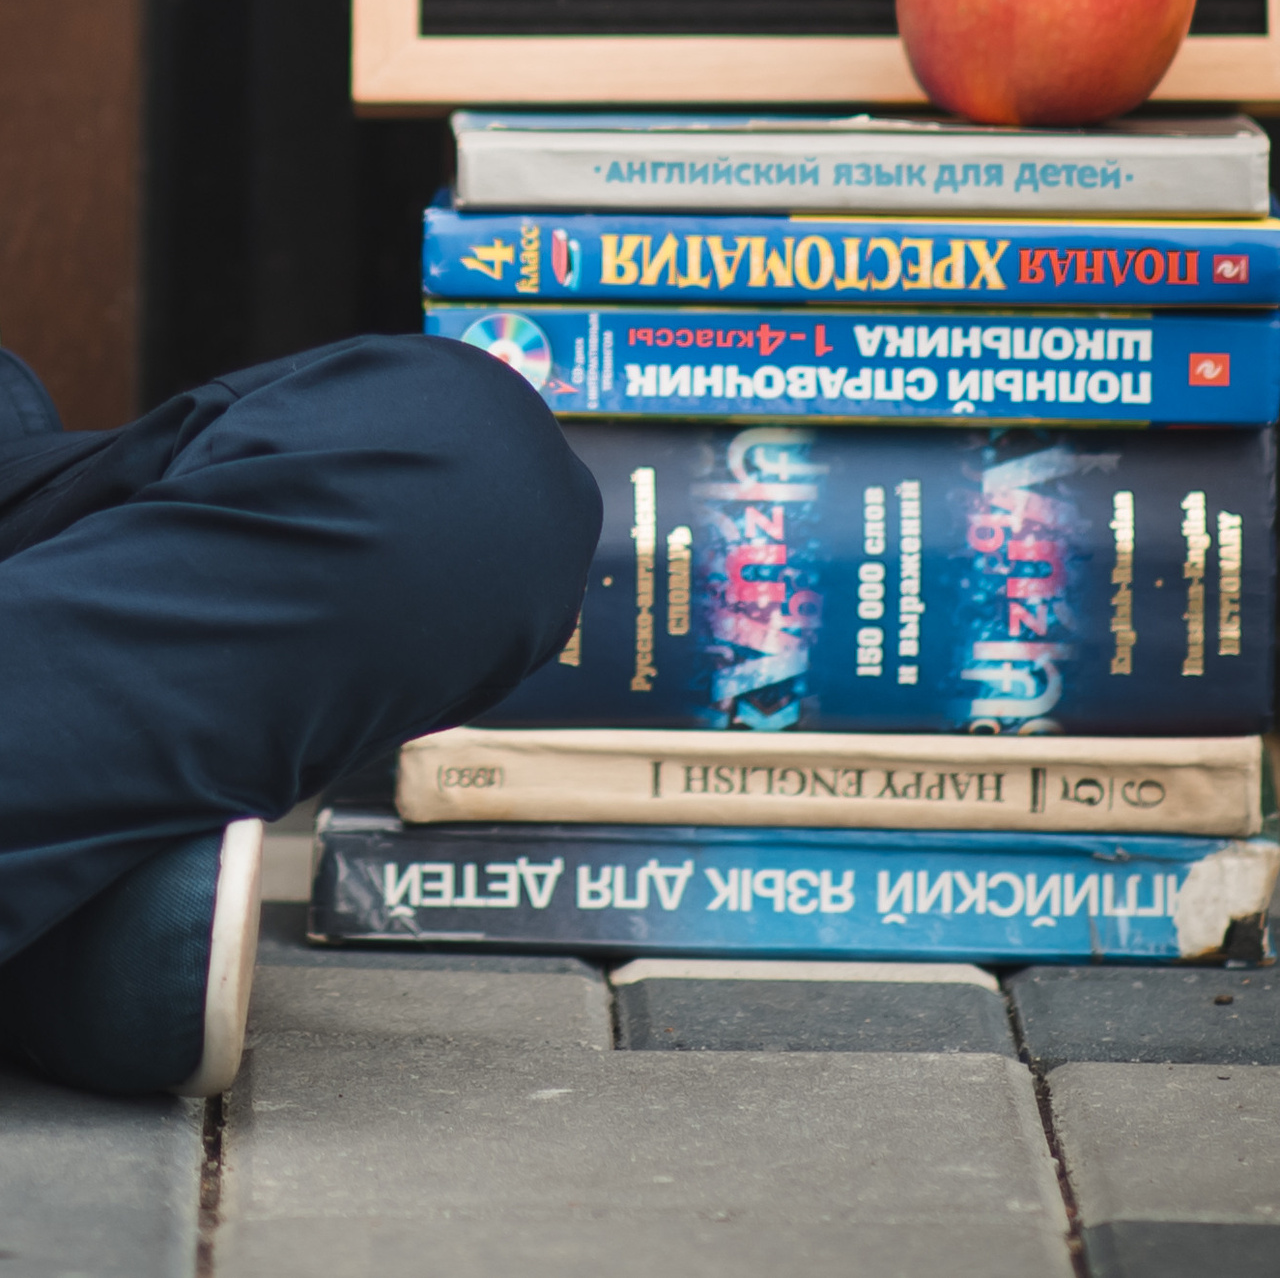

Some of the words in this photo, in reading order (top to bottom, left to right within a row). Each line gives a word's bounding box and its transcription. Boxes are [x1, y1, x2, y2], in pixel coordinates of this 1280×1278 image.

[459, 238, 516, 281] 4
[599, 232, 1011, 291] ХРЕСТОМАТИЯ
[1018, 246, 1201, 288] ПОЛНАЯ
[852, 325, 1154, 362] ШКОЛЬНИКА
[624, 363, 939, 402] СПРАВОЧНИК
[946, 368, 1154, 414] ПОЛНЫЙ
[862, 484, 887, 556] слов
[856, 562, 886, 620] 000
[894, 479, 926, 657] выражений
[1108, 490, 1138, 676] English-Russian
[1180, 490, 1212, 677] Russian-English
[1217, 510, 1243, 657] DICTIONARY
[856, 626, 885, 678] 150
[896, 664, 919, 686] и
[682, 763, 870, 801] ENGLISH
[877, 768, 1006, 803] HAPPY
[383, 856, 565, 918] ДЕТЕЙ
[575, 858, 695, 911] ДЛЯ
[704, 867, 856, 914] ЯЗЫК
